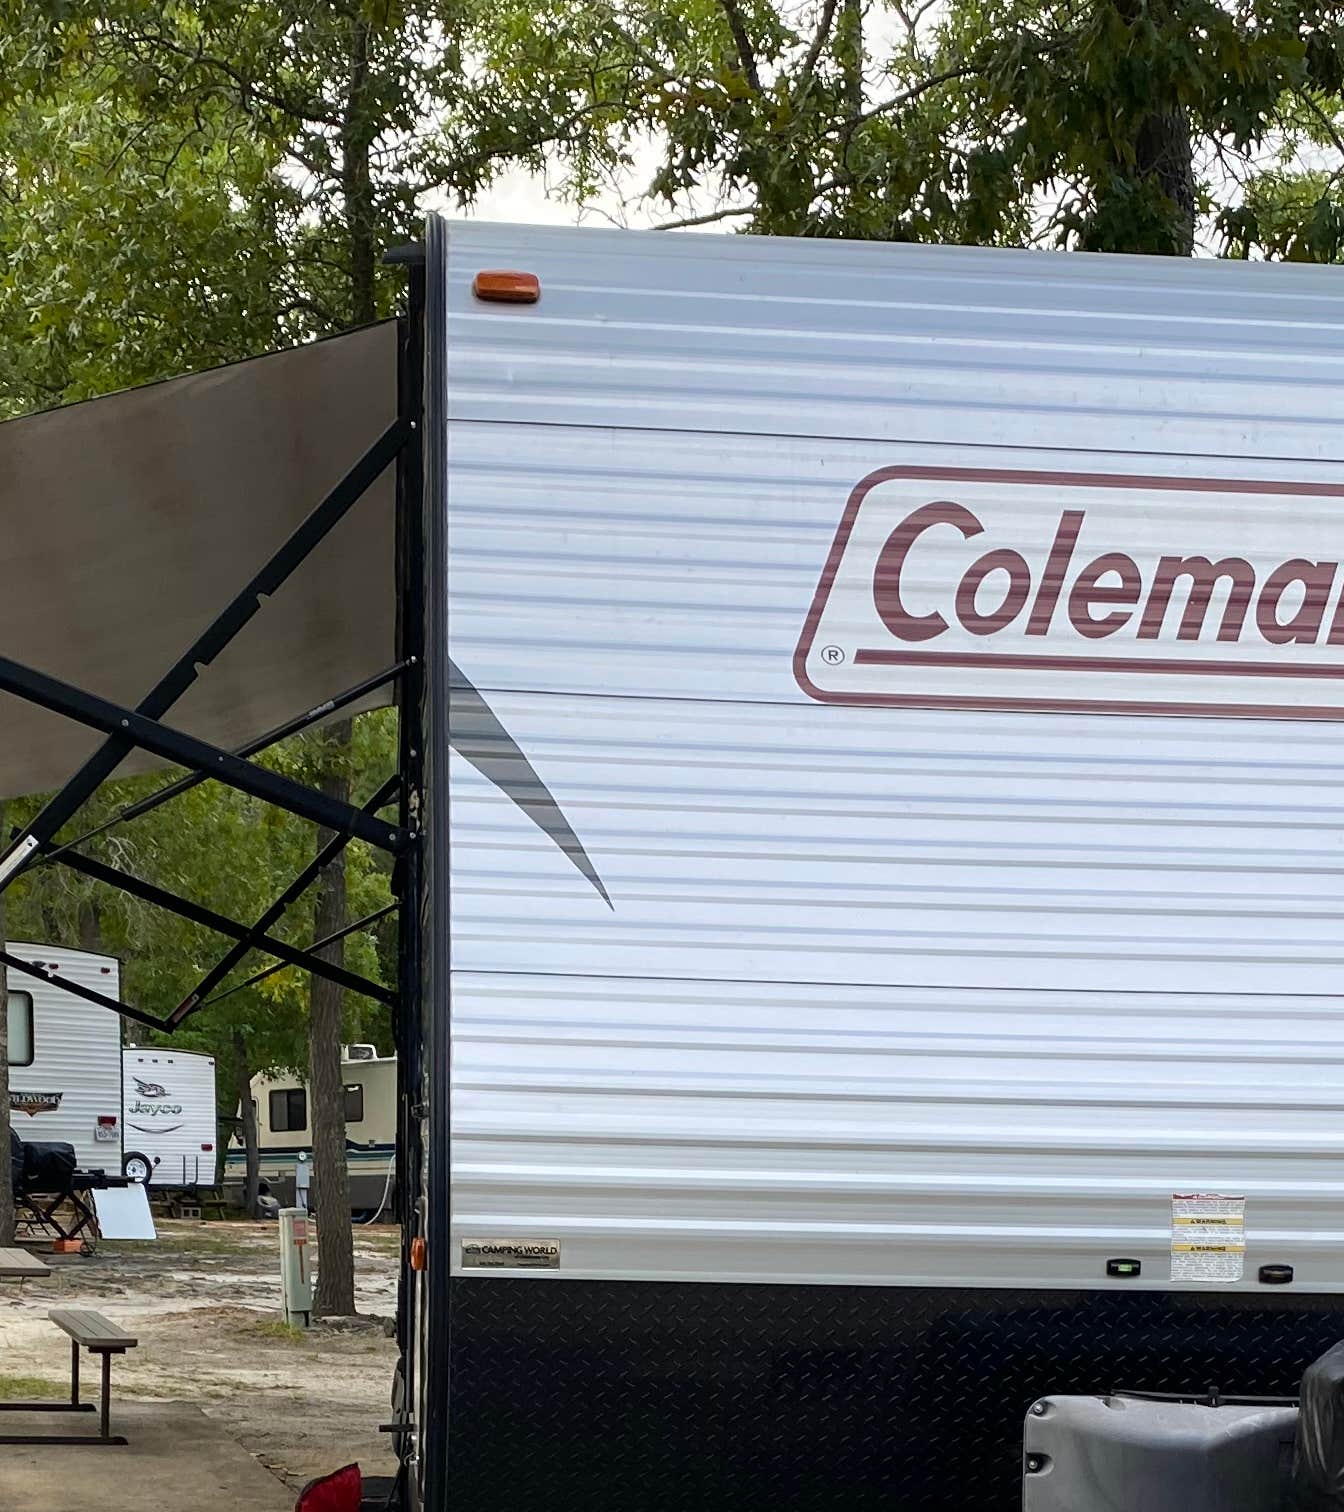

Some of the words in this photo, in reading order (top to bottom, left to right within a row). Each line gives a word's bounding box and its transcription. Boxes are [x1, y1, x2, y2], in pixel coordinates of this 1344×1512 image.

[128, 1101, 183, 1117] Jayco
[482, 1246, 522, 1255] CAMPING
[523, 1246, 557, 1255] WORLD
